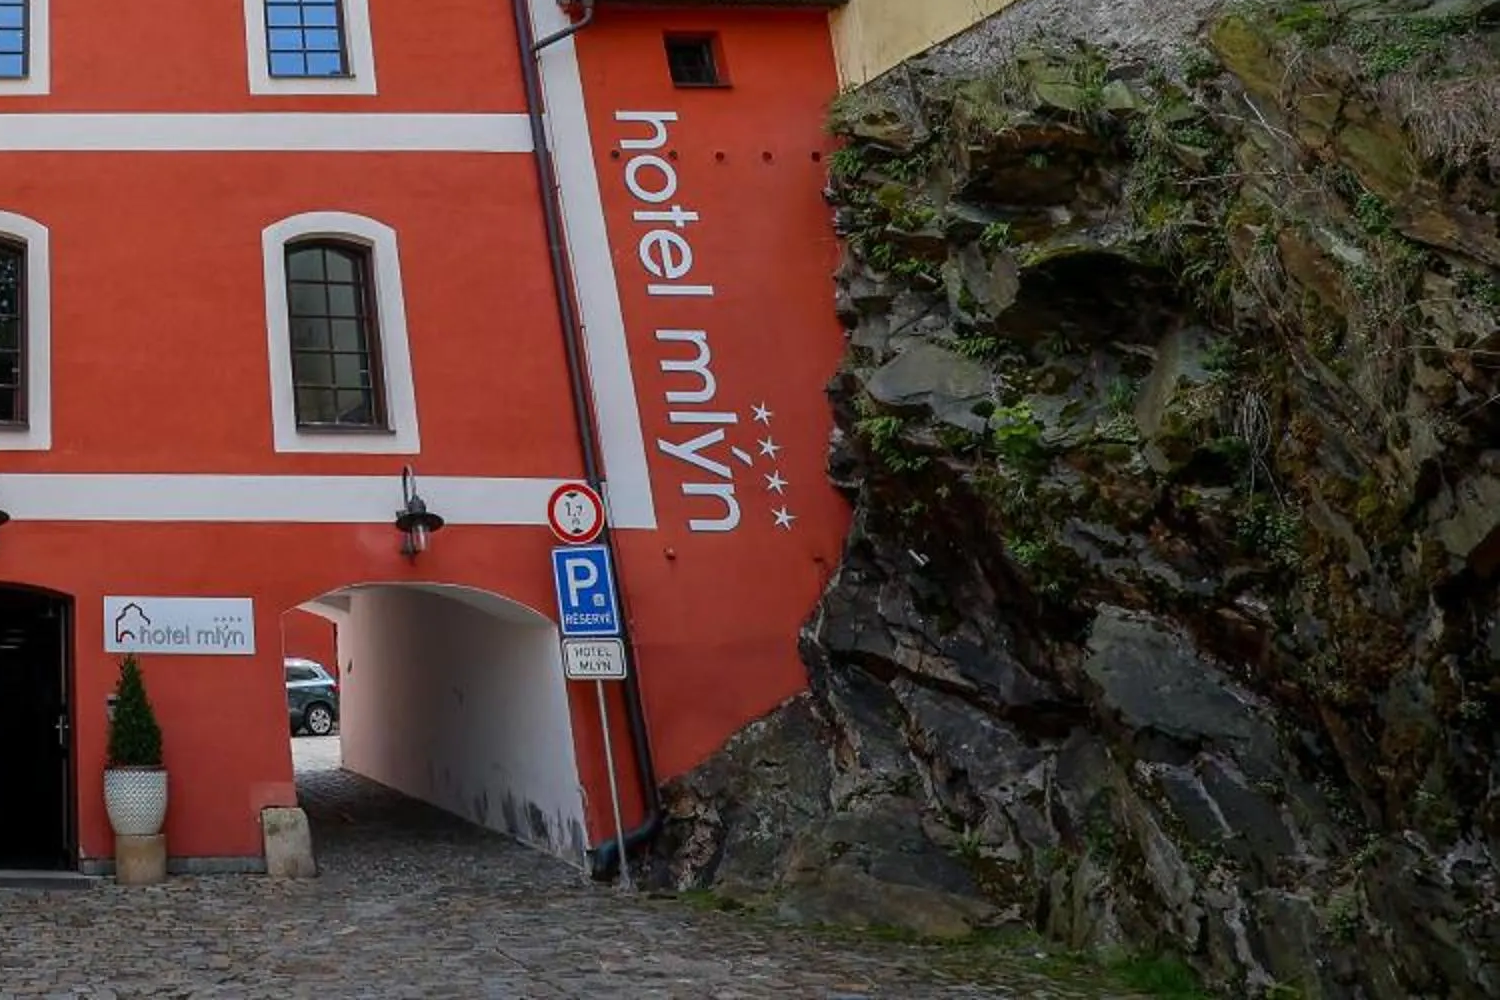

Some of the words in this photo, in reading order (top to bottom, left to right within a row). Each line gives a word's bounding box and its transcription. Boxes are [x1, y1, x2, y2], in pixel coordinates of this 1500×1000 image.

[615, 111, 714, 296] hotel
[656, 329, 753, 532] mlýn
[565, 558, 599, 607] P
[140, 625, 190, 645] hotel
[197, 625, 245, 648] mlýn
[573, 646, 612, 658] HOTEL
